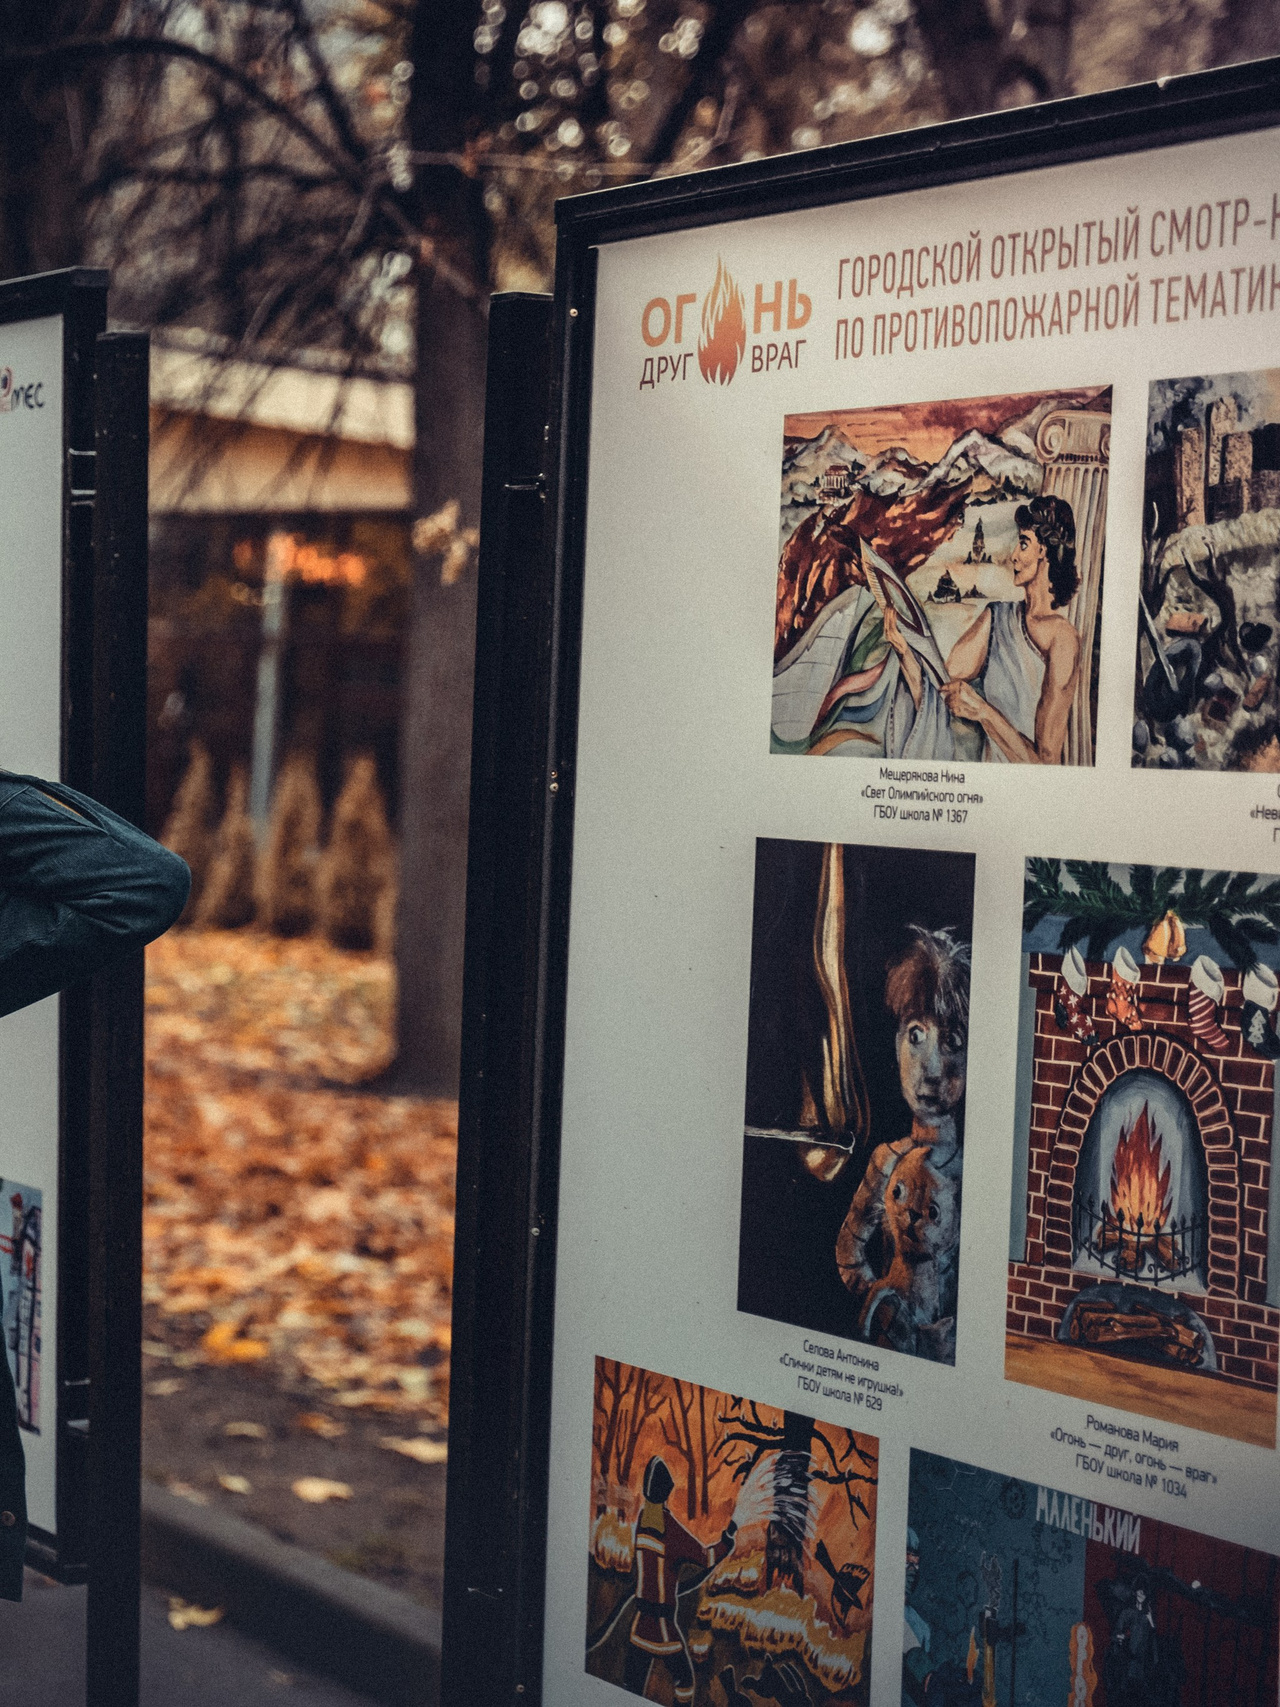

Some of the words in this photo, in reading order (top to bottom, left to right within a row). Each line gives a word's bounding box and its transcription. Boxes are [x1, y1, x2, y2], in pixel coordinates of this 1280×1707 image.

[837, 229, 982, 300] ГОРОДСКОЙ
[990, 205, 1141, 279] ОТКРЫТЫЙ
[834, 316, 865, 361] ПО
[872, 271, 1140, 356] ПРОТИВОПОЖАРНОЙ
[639, 352, 694, 391] ДРУГ
[751, 339, 807, 373] ВРАГ
[860, 784, 886, 799] «Свет
[887, 786, 955, 803] Олимпийского
[956, 793, 984, 804] огня»
[879, 766, 939, 784] Мещерякова
[940, 769, 966, 784] Нина
[873, 804, 898, 819] ГБОУ
[899, 809, 930, 821] школа
[932, 808, 943, 822] №
[946, 808, 968, 823] 1367
[1250, 804, 1280, 820] «Нев
[779, 1352, 815, 1373] «Спички
[815, 1364, 843, 1381] детям
[844, 1373, 856, 1385] не
[857, 1376, 904, 1397] игрушка!»
[803, 1339, 835, 1360] Селова
[836, 1348, 880, 1372] Антонина
[797, 1375, 822, 1394] ГБОУ
[822, 1385, 852, 1403] школа
[853, 1391, 865, 1406] №
[865, 1394, 883, 1411] 629
[1086, 1414, 1140, 1442] Романова
[1141, 1429, 1180, 1453] Мария
[1050, 1427, 1087, 1449] «Огонь
[1104, 1444, 1132, 1464] друг,
[1134, 1452, 1167, 1471] огонь
[1184, 1466, 1218, 1485] враг»
[1075, 1453, 1105, 1474] ГБОУ
[1106, 1466, 1143, 1487] школа
[1144, 1473, 1158, 1489] №
[1161, 1478, 1188, 1499] 1034
